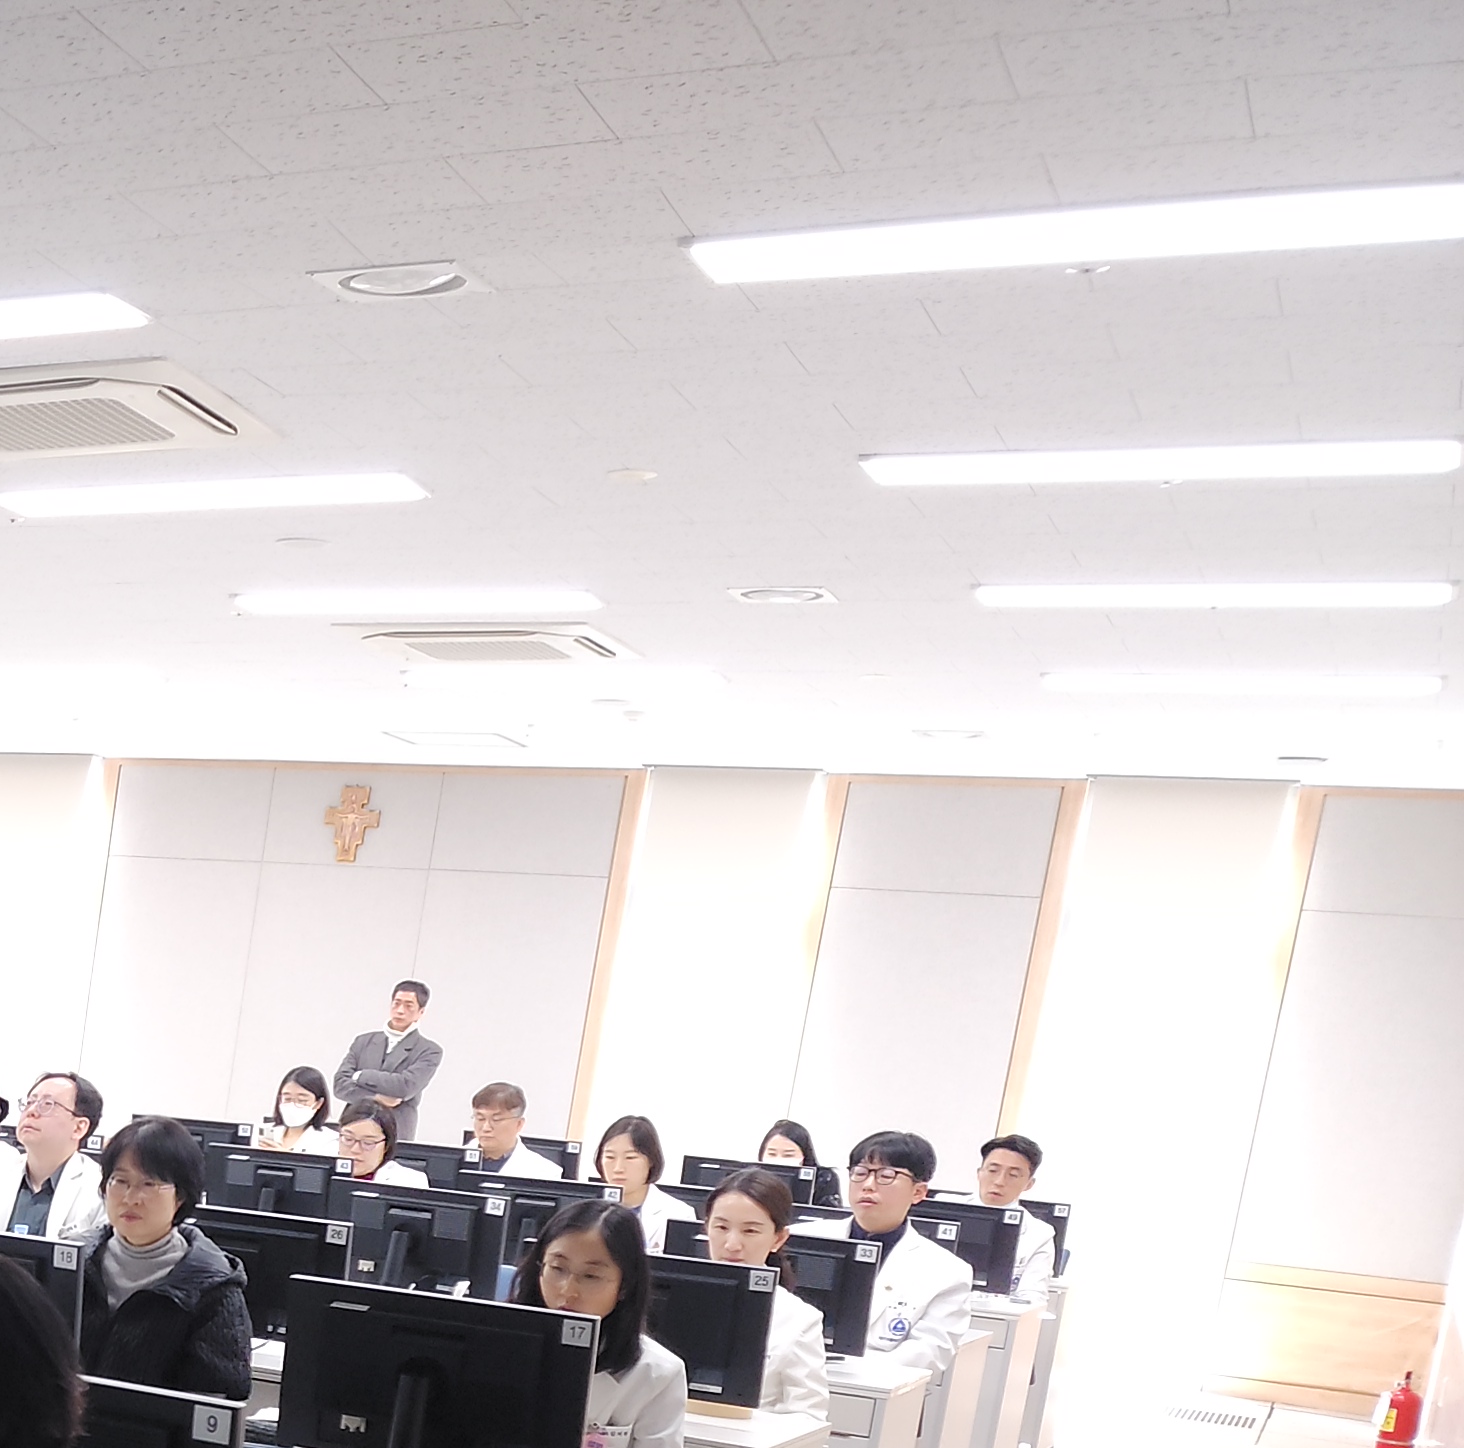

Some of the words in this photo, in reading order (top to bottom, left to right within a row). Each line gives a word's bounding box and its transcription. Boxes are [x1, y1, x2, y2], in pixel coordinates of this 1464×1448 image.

[607, 1190, 618, 1199] 42
[490, 1201, 502, 1211] 34
[330, 1229, 343, 1240] 26
[941, 1228, 953, 1236] 41
[59, 1251, 72, 1264] 18
[860, 1248, 873, 1259] 33
[754, 1275, 769, 1287] 25
[569, 1326, 587, 1340] 17
[207, 1415, 219, 1434] 9
